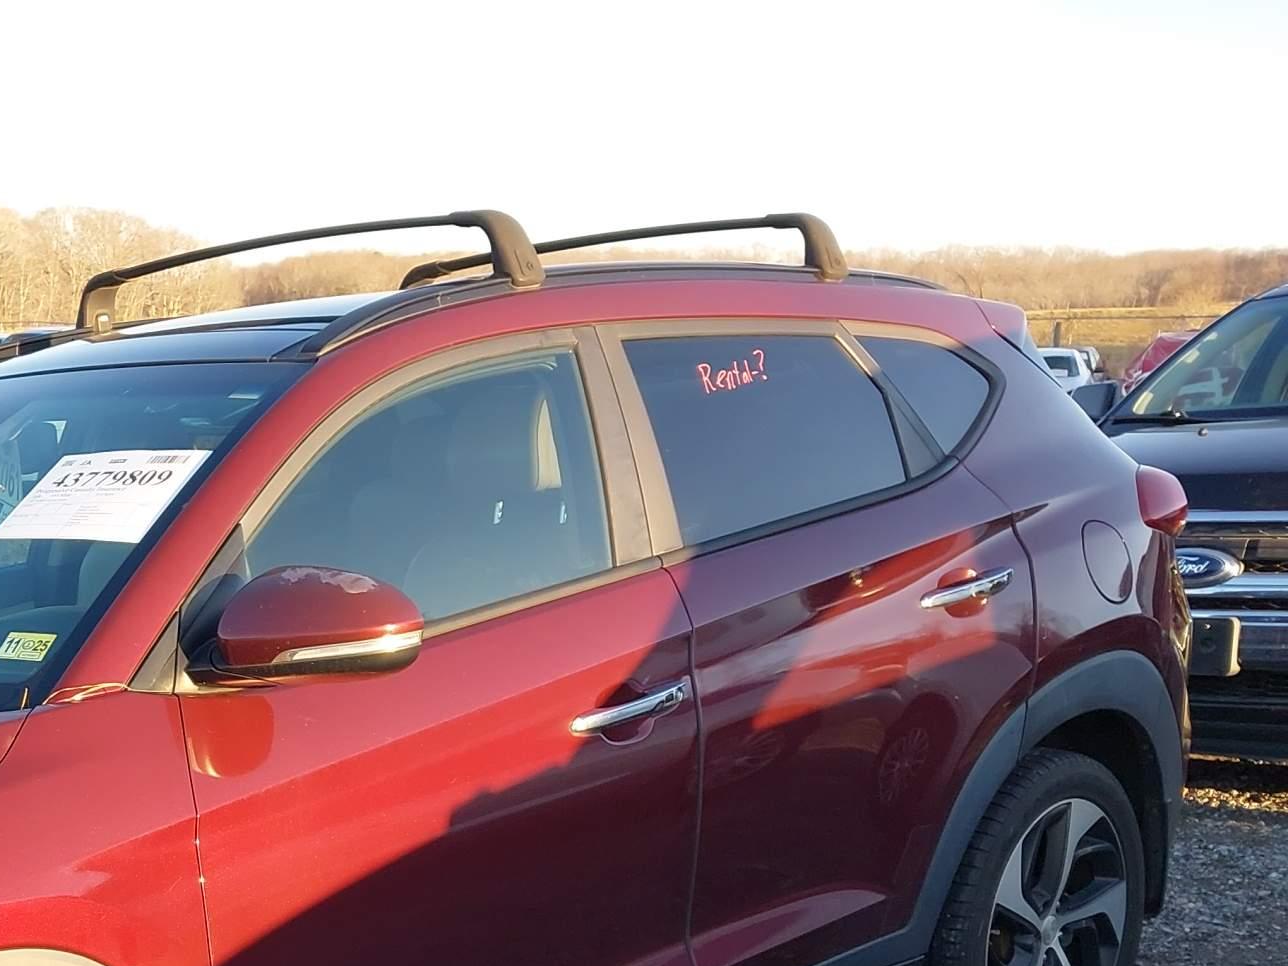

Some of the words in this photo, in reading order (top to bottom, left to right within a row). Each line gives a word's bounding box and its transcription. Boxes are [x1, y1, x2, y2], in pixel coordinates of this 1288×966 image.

[53, 469, 174, 488] 43779809
[5, 637, 22, 653] 11
[32, 639, 51, 651] 25
